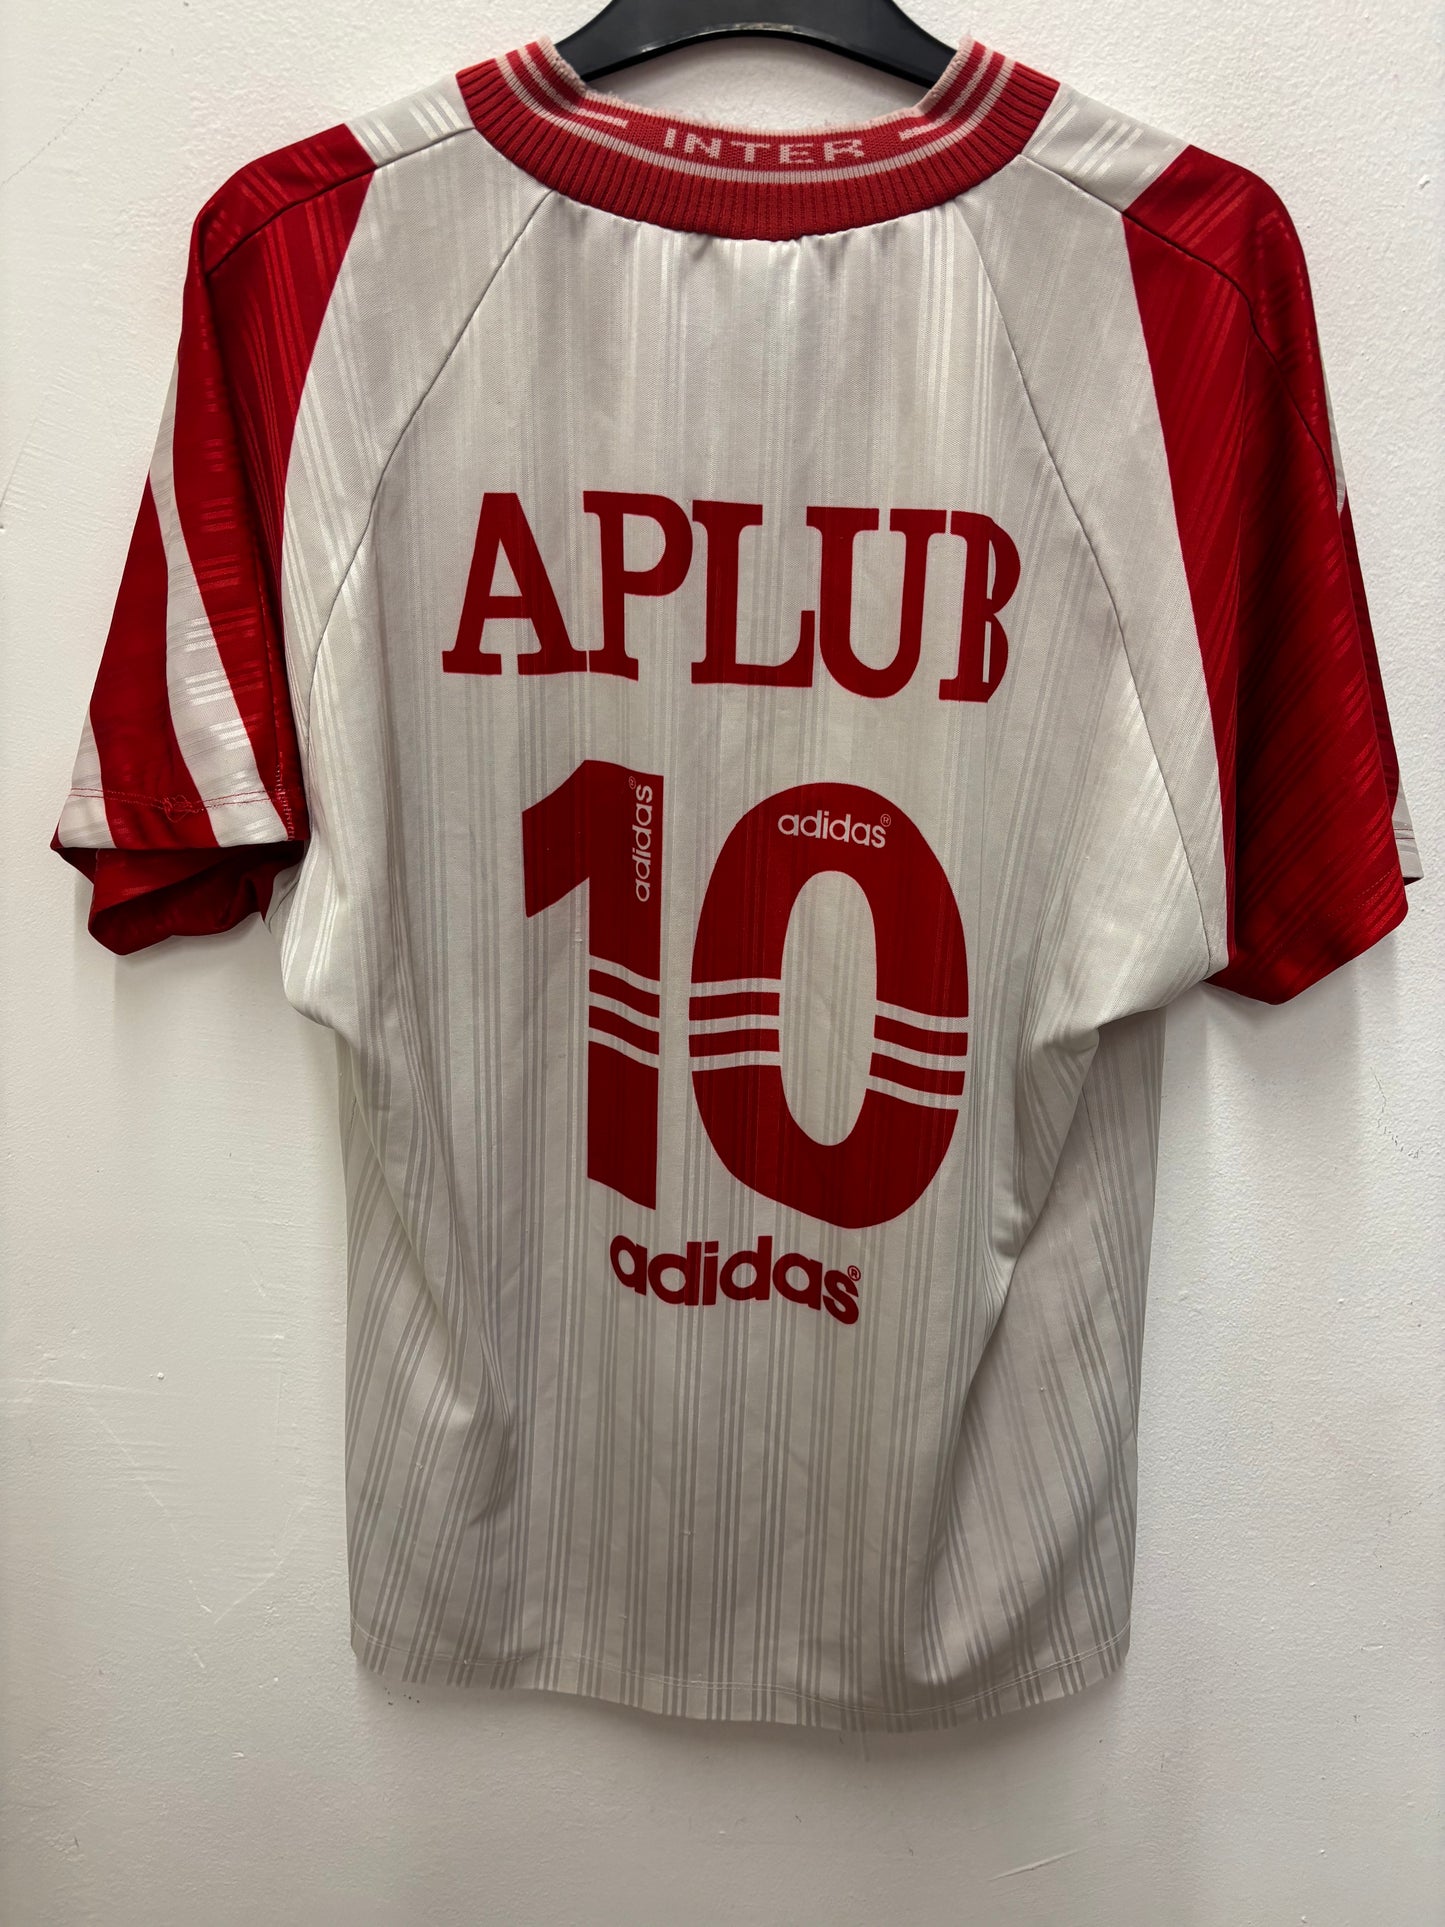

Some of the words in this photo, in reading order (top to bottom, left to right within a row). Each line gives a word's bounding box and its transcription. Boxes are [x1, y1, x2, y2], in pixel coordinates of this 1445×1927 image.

[663, 127, 866, 165] INTER
[442, 490, 1021, 703] APLUB
[522, 759, 969, 1229] 10
